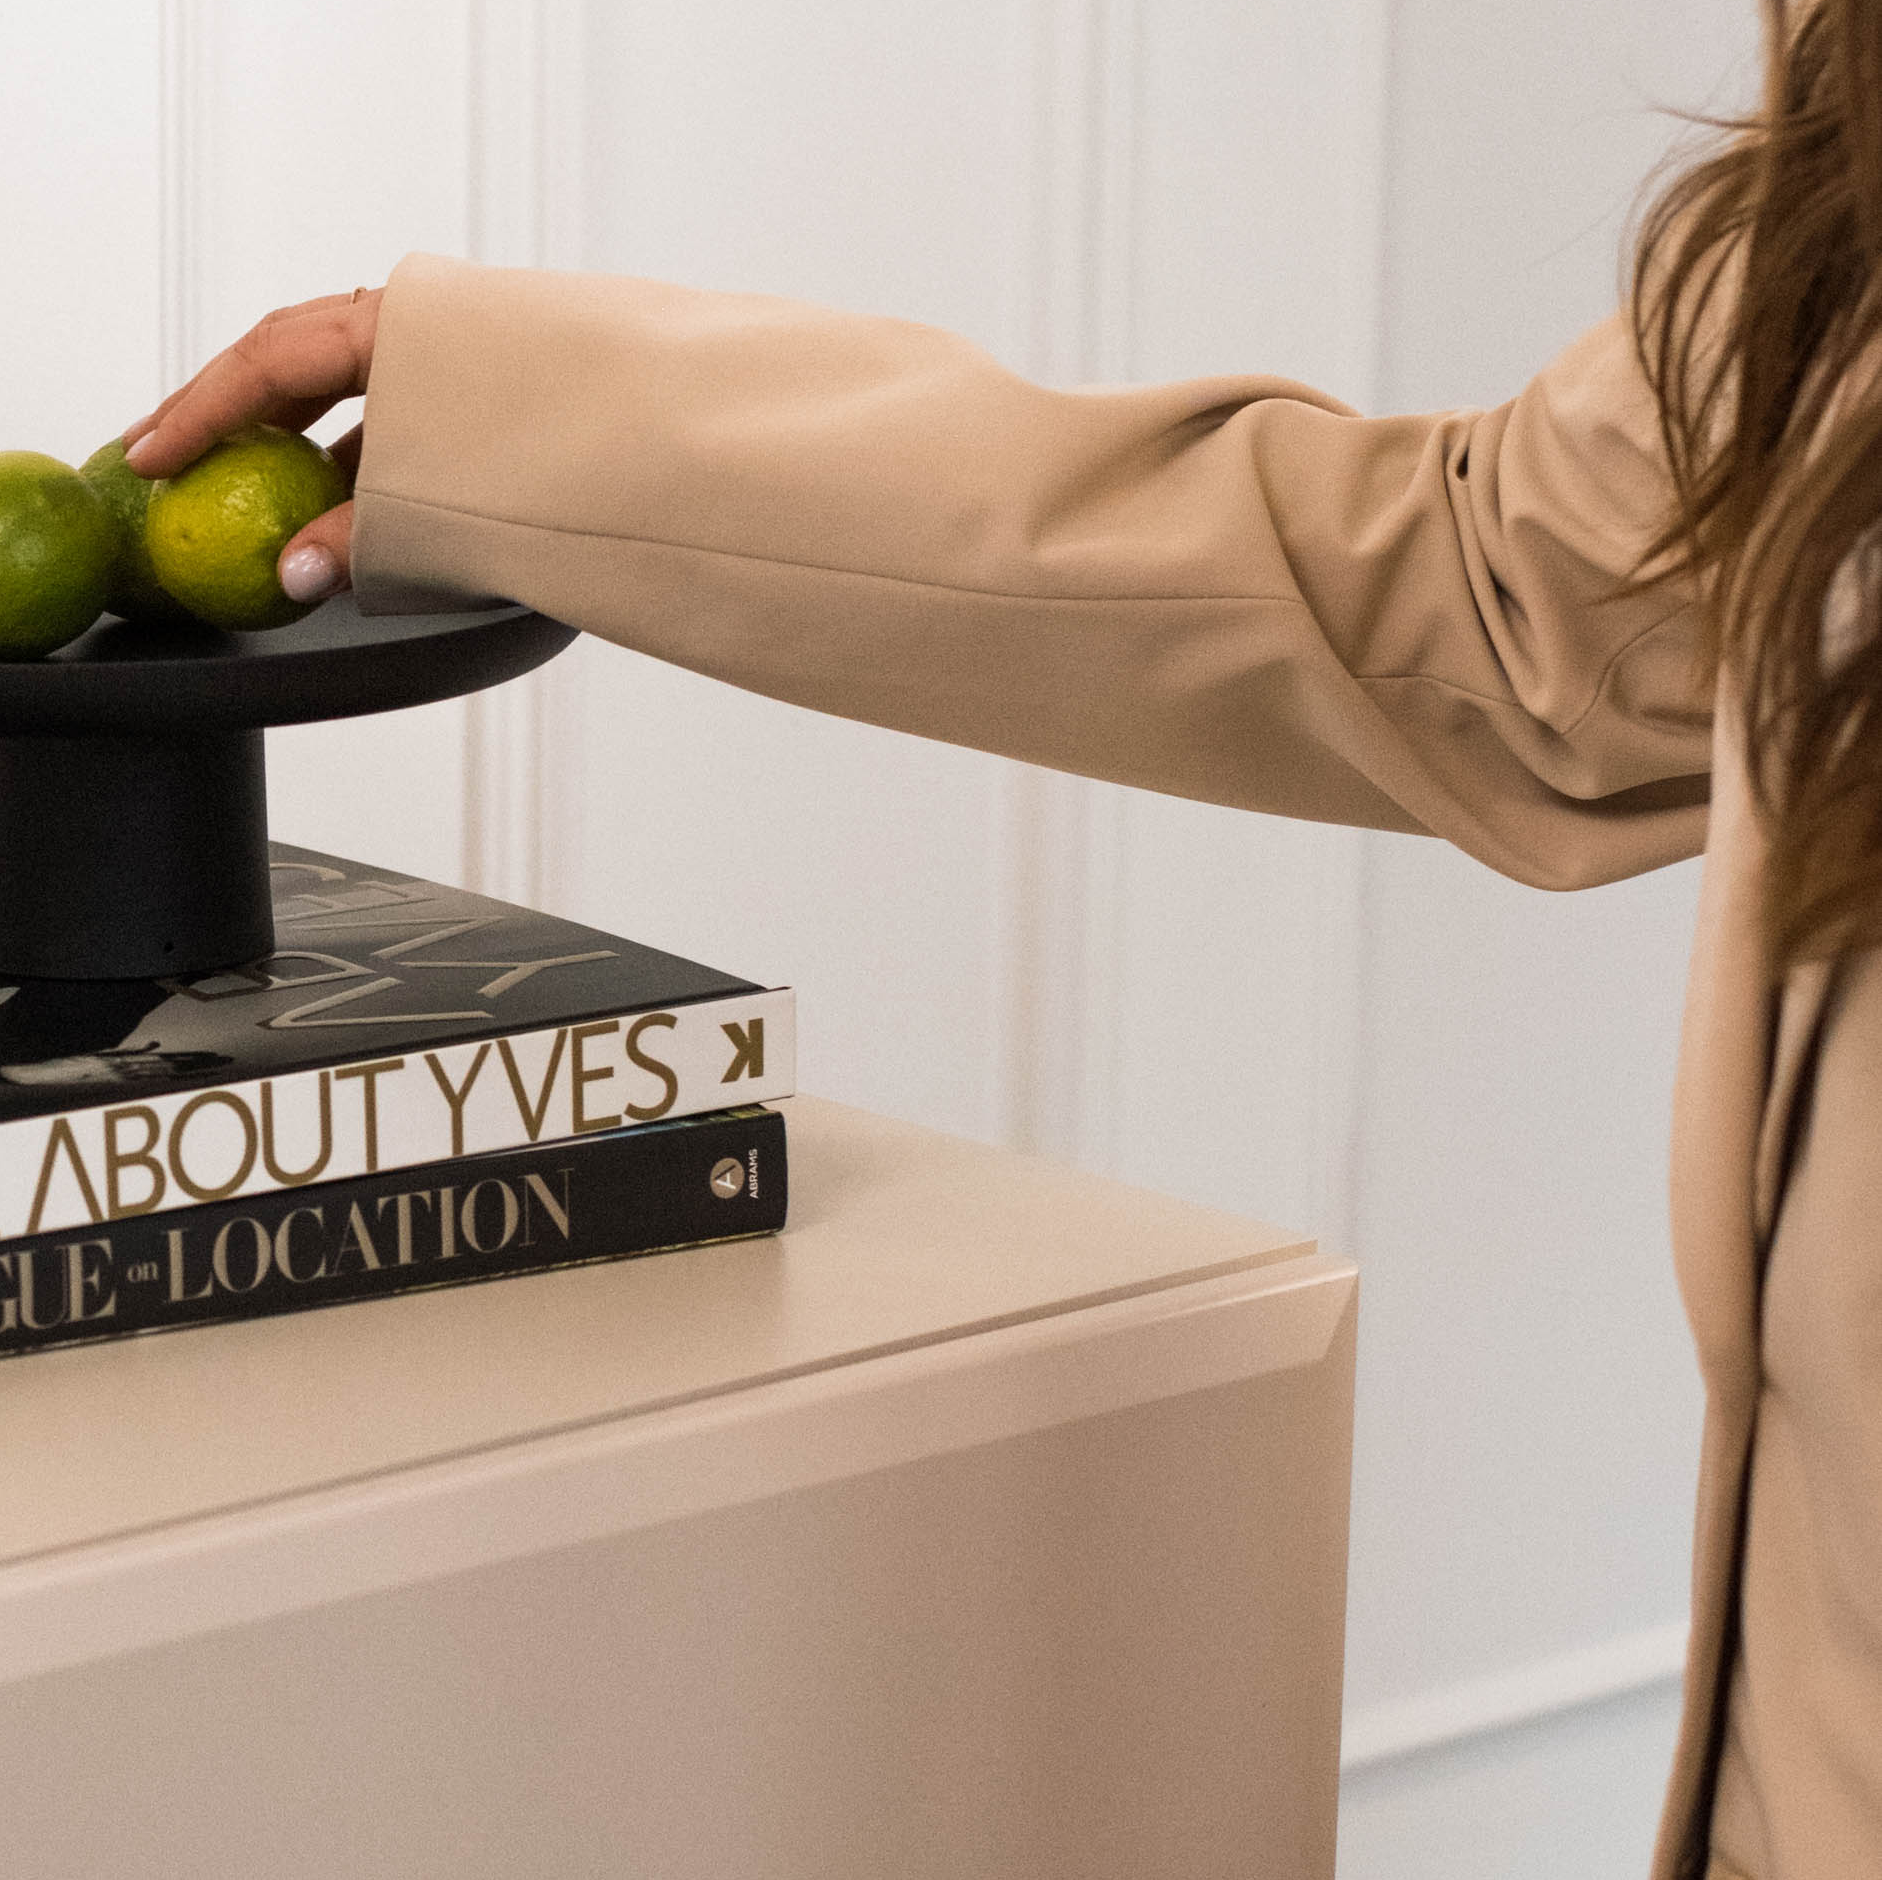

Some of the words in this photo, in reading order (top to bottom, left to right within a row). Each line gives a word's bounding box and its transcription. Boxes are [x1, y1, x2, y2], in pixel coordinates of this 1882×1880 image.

[25, 1057, 405, 1235] ABOUT
[423, 1012, 679, 1157] YVES
[748, 1147, 759, 1200] ABRAMS
[126, 1258, 160, 1284] on
[162, 1167, 576, 1304] LOCATION
